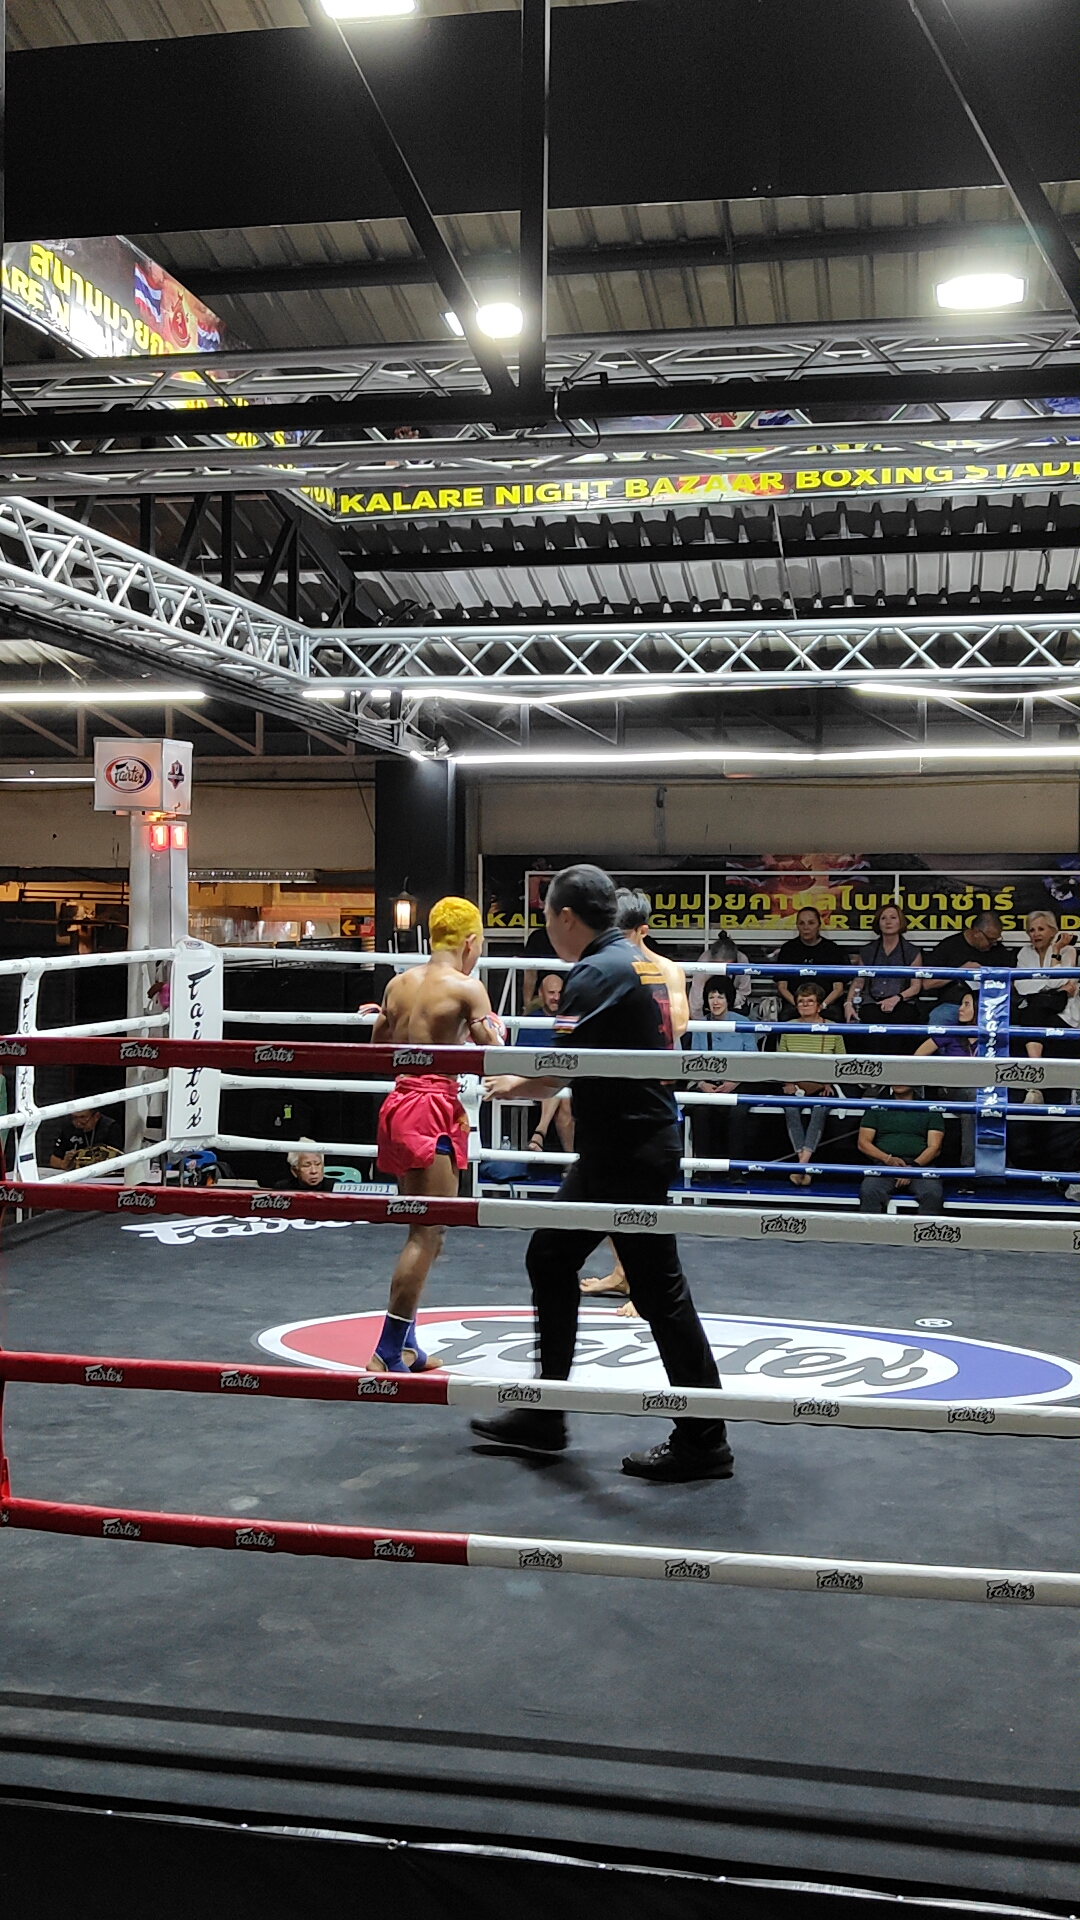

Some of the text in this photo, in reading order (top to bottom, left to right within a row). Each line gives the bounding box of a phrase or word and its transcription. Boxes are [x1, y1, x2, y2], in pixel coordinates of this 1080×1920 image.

[340, 487, 484, 514] KALARE
[495, 480, 613, 506] NIGHT
[625, 472, 785, 498] BAZAAR
[795, 465, 953, 491] BOXING
[965, 461, 1080, 480] STADI
[114, 762, 145, 785] Fairtex
[647, 914, 707, 929] GHT
[120, 1041, 159, 1059] Fairtex
[254, 1045, 294, 1063] Fairtex
[392, 1049, 433, 1067] Fairtex
[682, 1054, 727, 1074] Fairtex
[835, 1058, 882, 1077] Fairtex
[995, 1063, 1044, 1083] Fairtex
[117, 1189, 156, 1207] Fairtex
[250, 1193, 291, 1211] Fairtex
[386, 1199, 428, 1215] Fairtex
[613, 1208, 657, 1226] Fairtex
[760, 1214, 806, 1233] Fairtex
[913, 1222, 961, 1243] Fairtex
[84, 1364, 123, 1383] Fairtex
[220, 1369, 260, 1389] Fairtex
[357, 1376, 398, 1396] Fairtex
[642, 1390, 687, 1411] Fairtex
[793, 1397, 839, 1417] Fairtex
[947, 1404, 995, 1424] Fairtex
[102, 1517, 1035, 1600] Fairtex Fairtex Fairtex Fairtex Fairtex Fairtex Fairtex
